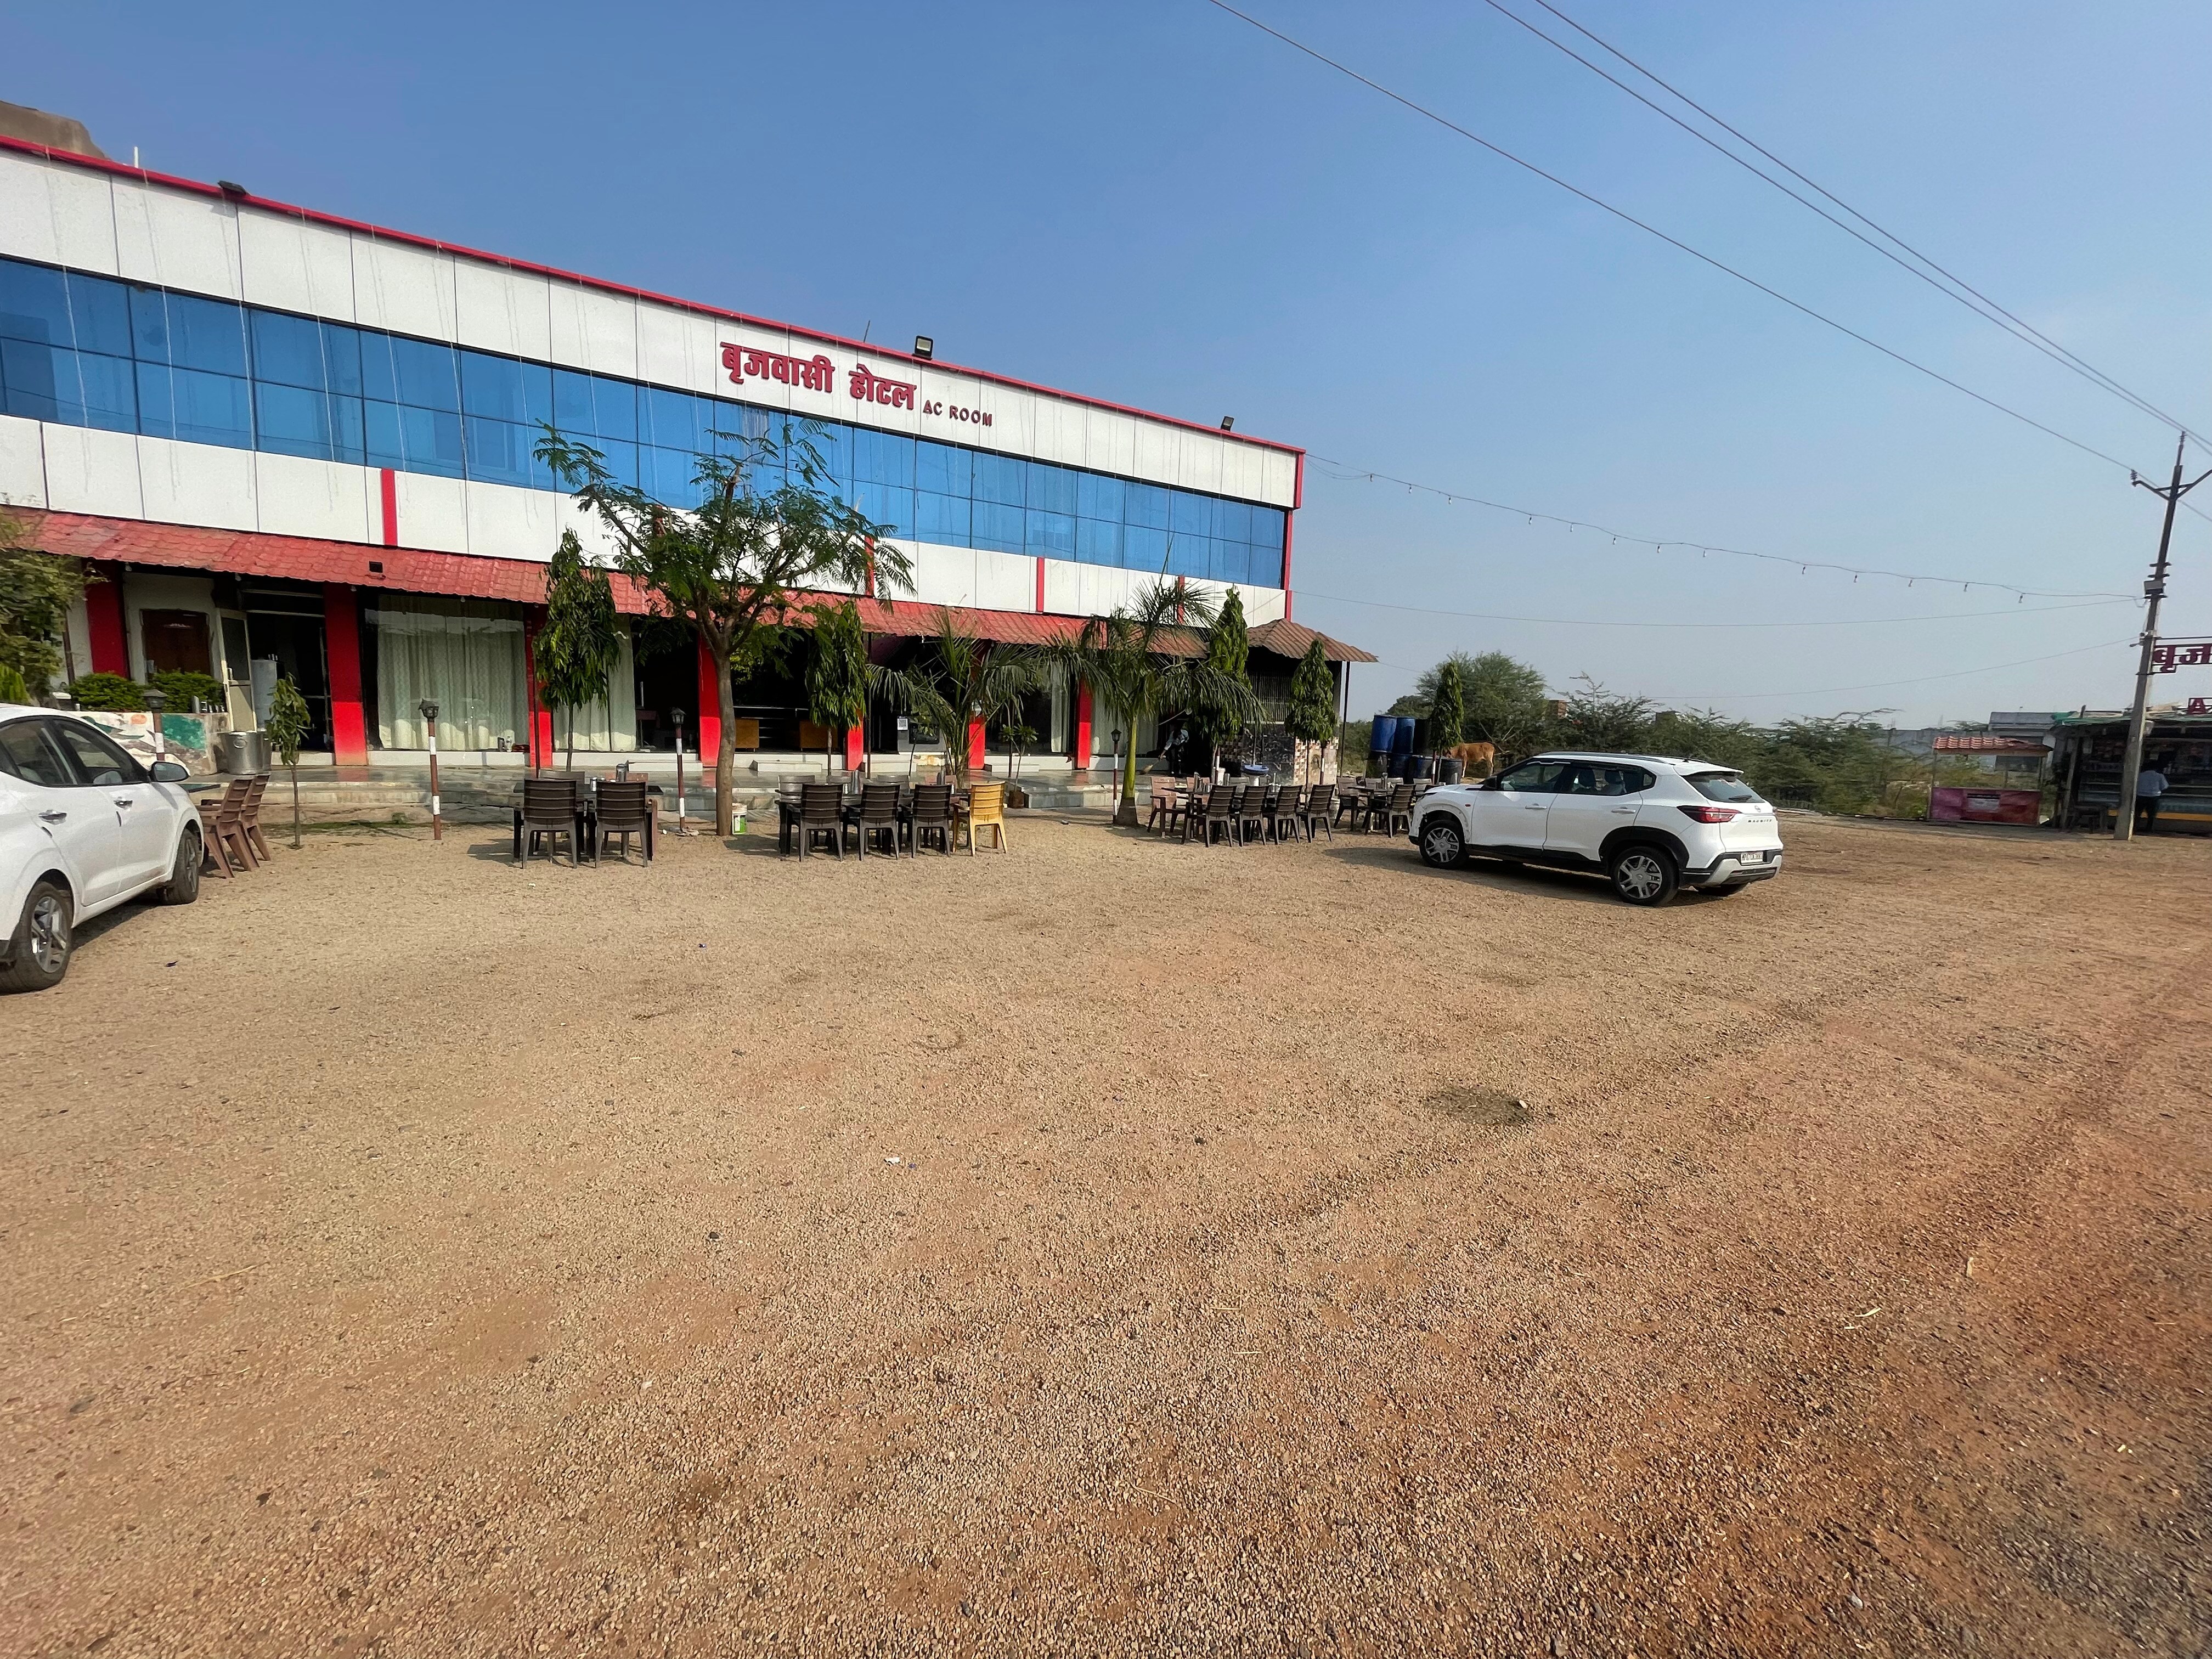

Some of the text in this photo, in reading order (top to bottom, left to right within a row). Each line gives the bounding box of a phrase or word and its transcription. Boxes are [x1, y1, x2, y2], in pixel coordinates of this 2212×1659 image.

[720, 341, 917, 410] बृजवासी होटल
[923, 399, 992, 427] AC ROOM
